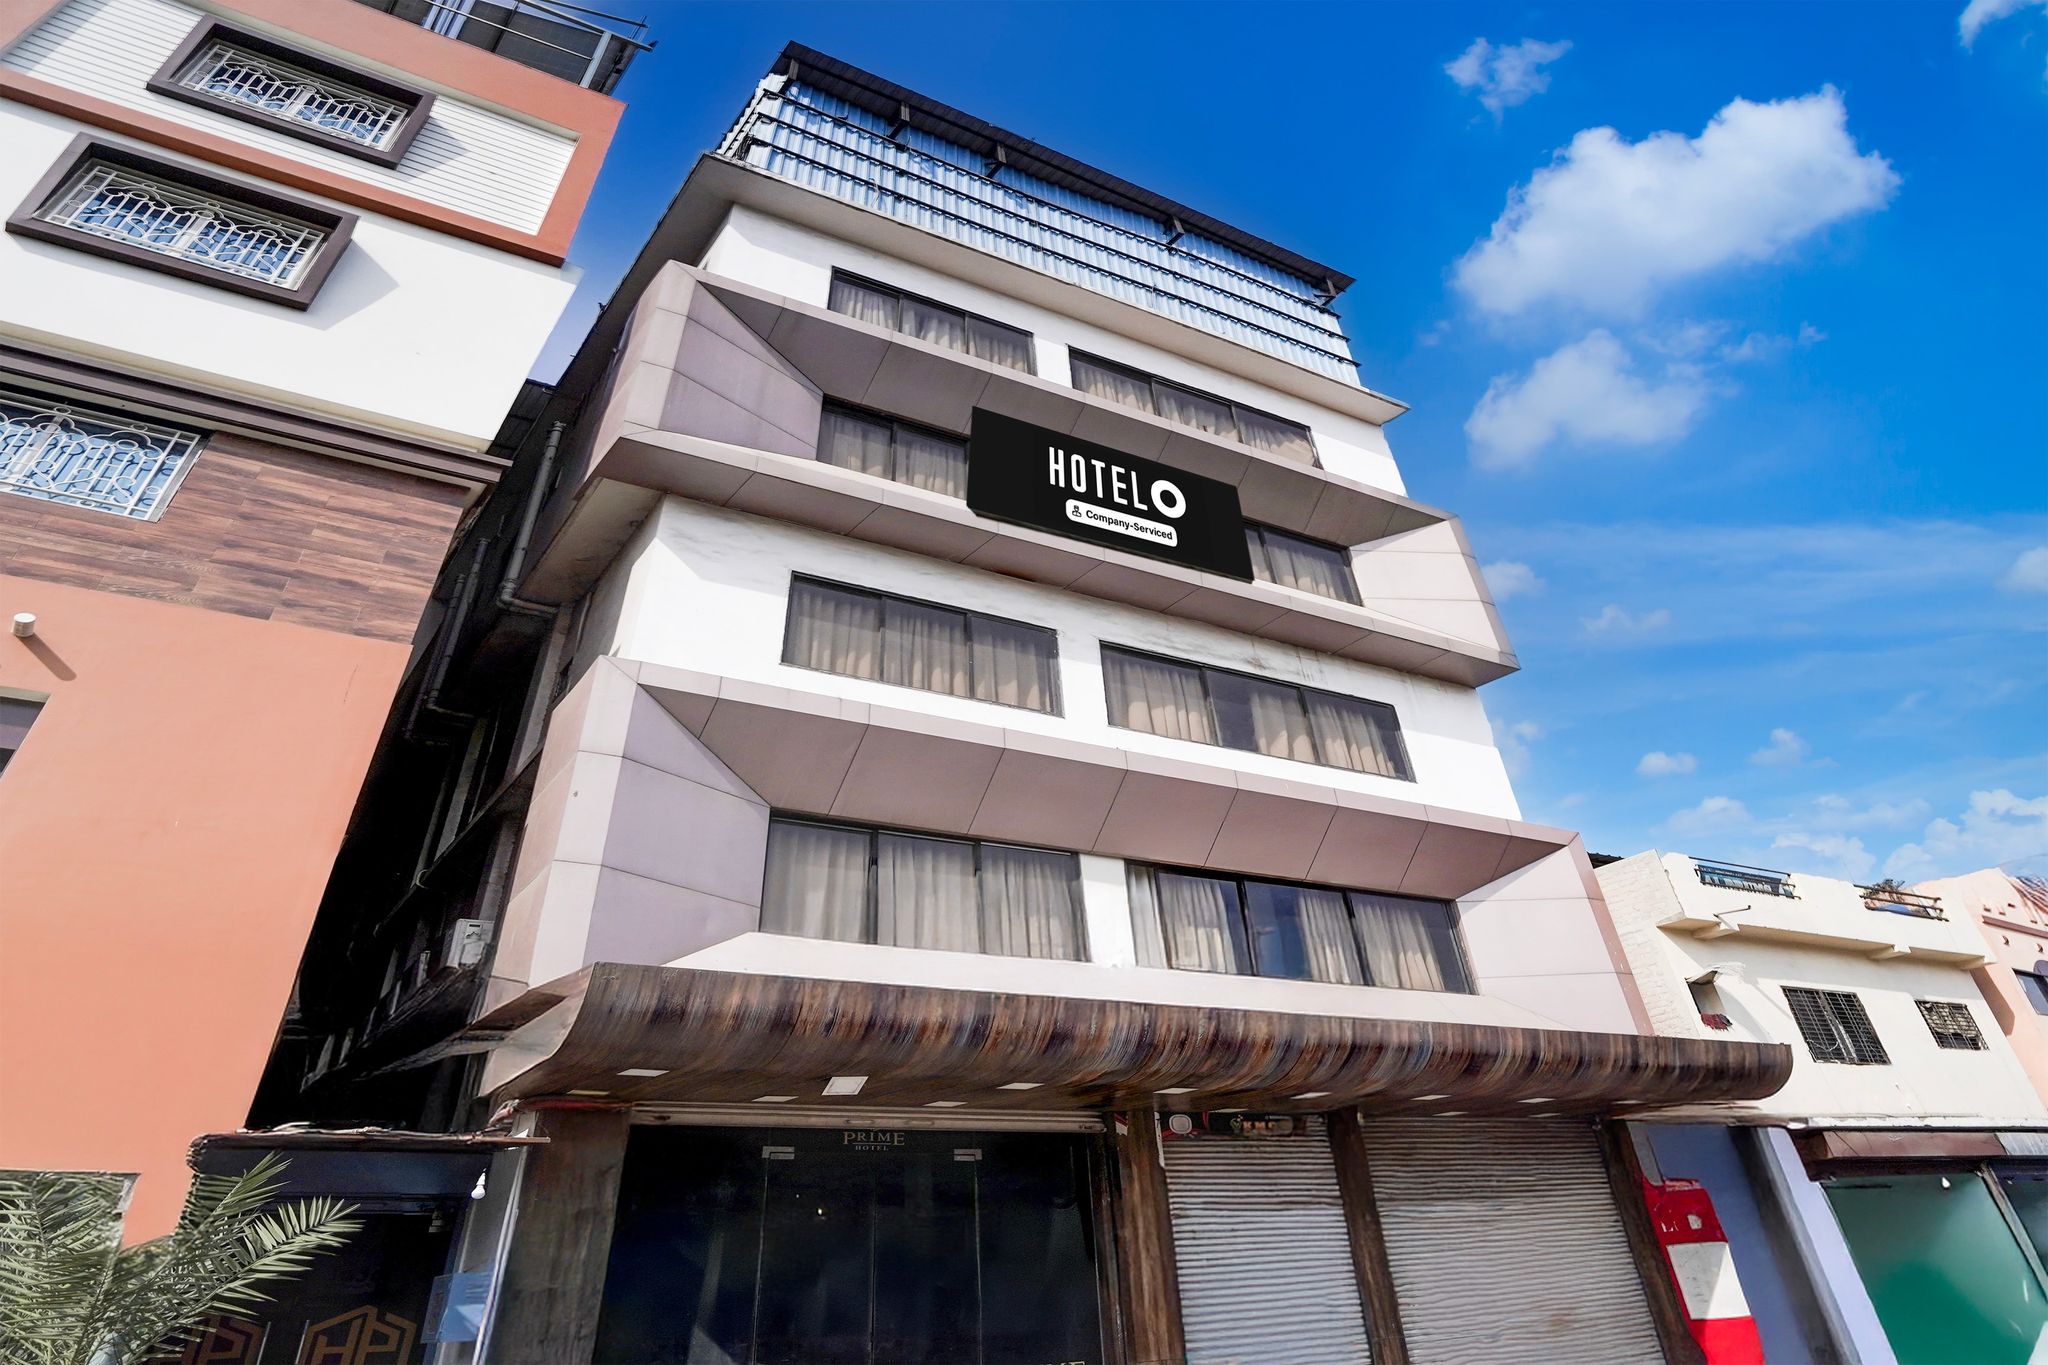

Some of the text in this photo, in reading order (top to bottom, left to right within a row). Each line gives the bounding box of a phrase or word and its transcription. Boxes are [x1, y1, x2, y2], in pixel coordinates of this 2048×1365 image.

[1049, 446, 1148, 511] HOTEL
[1085, 509, 1173, 540] Company-Serviced
[843, 1131, 905, 1145] PRIME
